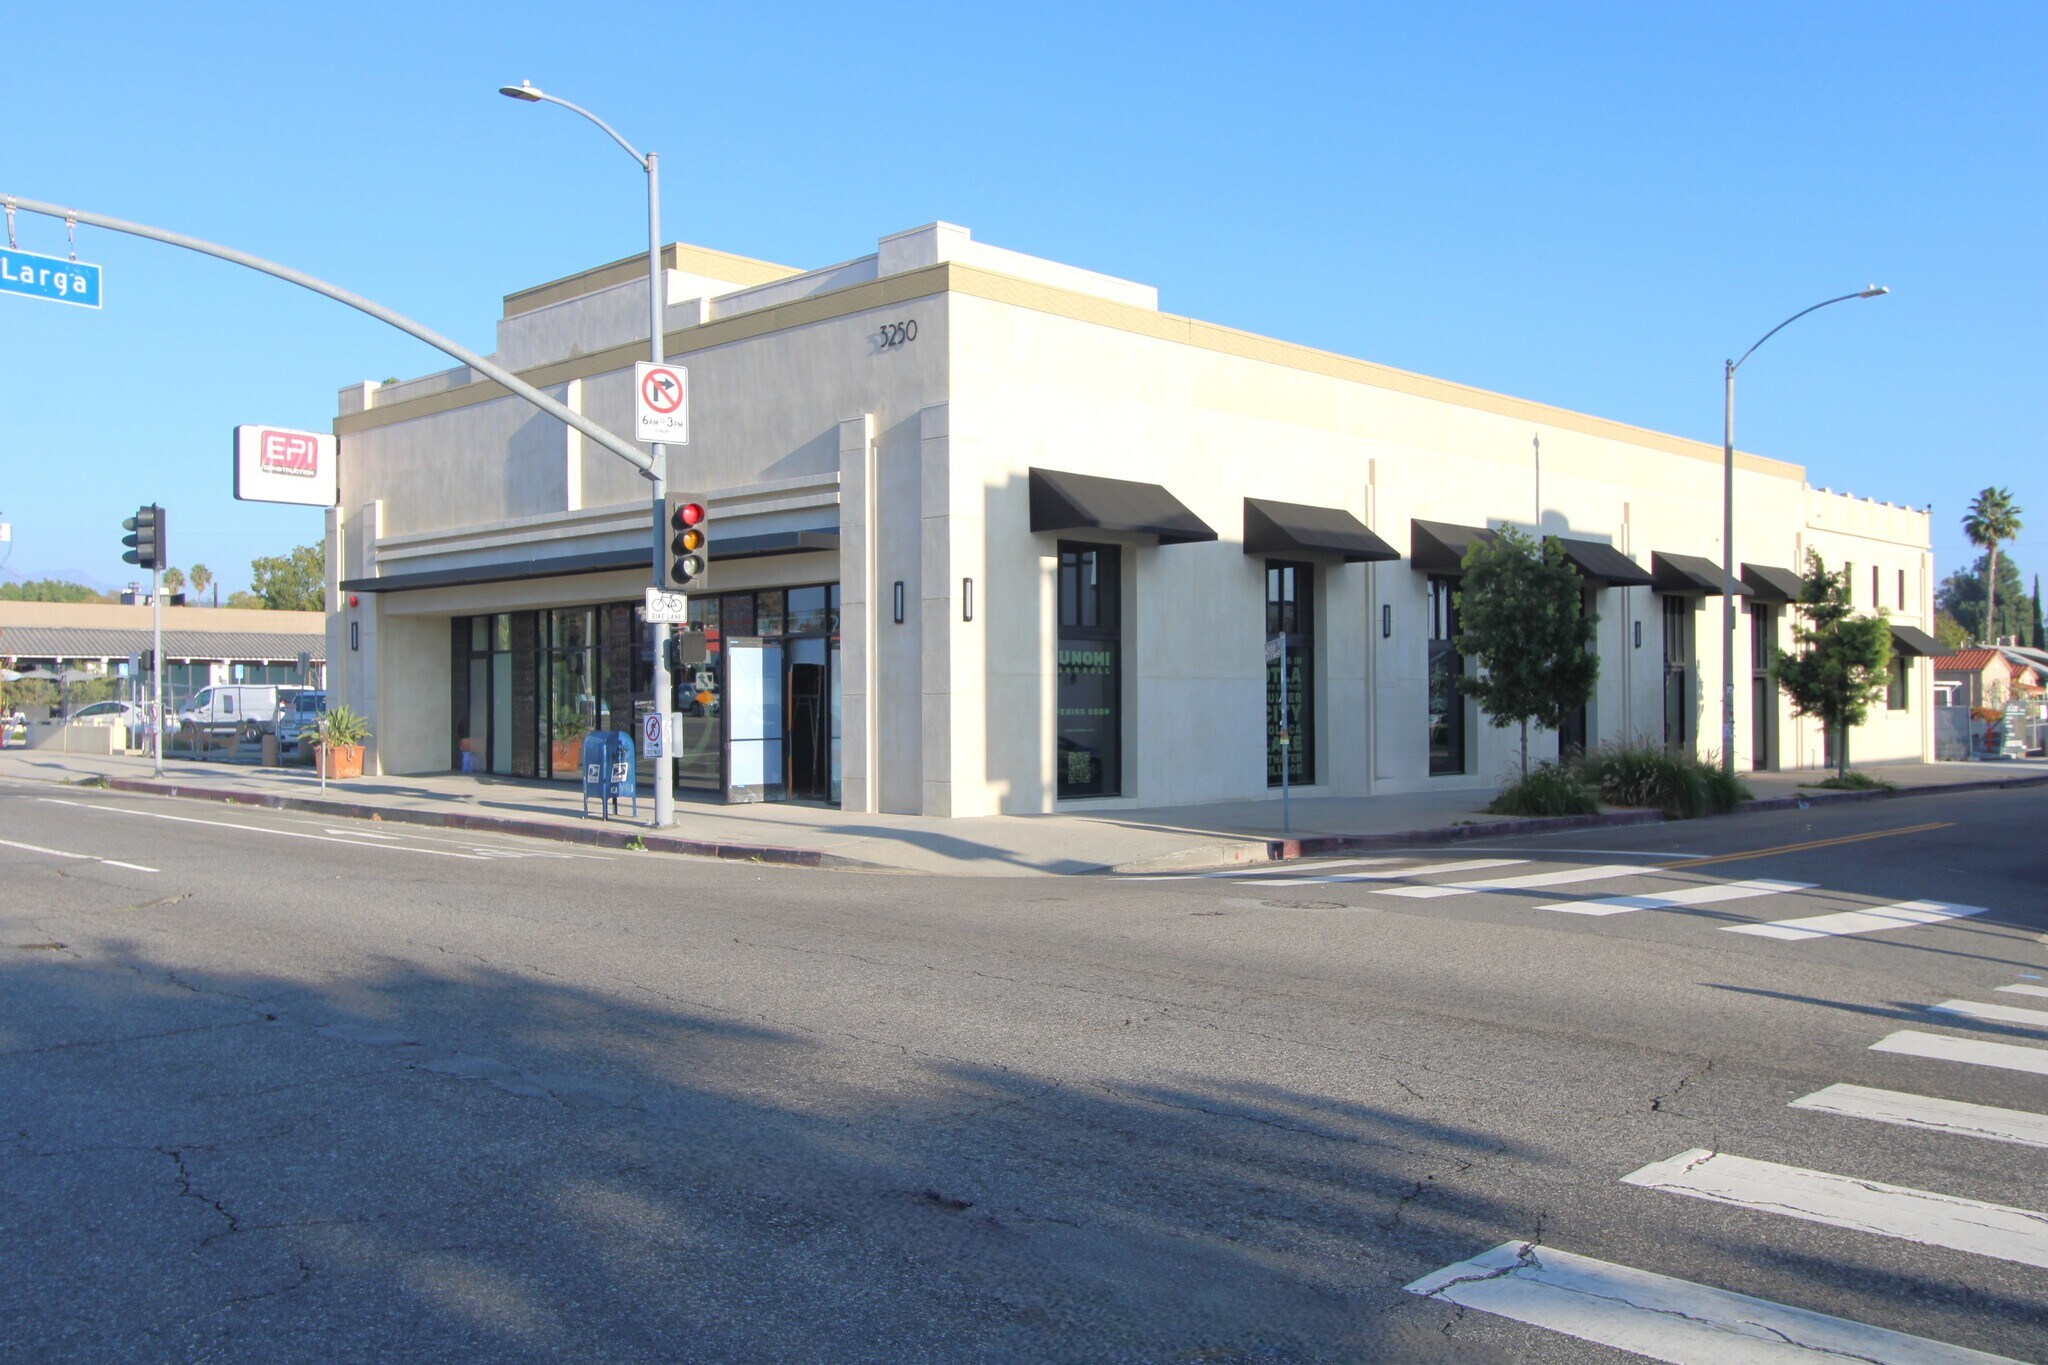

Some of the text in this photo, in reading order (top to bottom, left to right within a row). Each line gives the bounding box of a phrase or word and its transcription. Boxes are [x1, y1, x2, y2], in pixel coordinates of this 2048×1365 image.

[2, 257, 87, 296] Larga
[880, 319, 917, 348] 3250
[267, 435, 313, 464] EPI
[263, 464, 315, 476] CONSTRUCTION
[1268, 693, 1302, 704] ULER
[1088, 708, 1110, 716] SOON
[1268, 725, 1302, 736] OLCA
